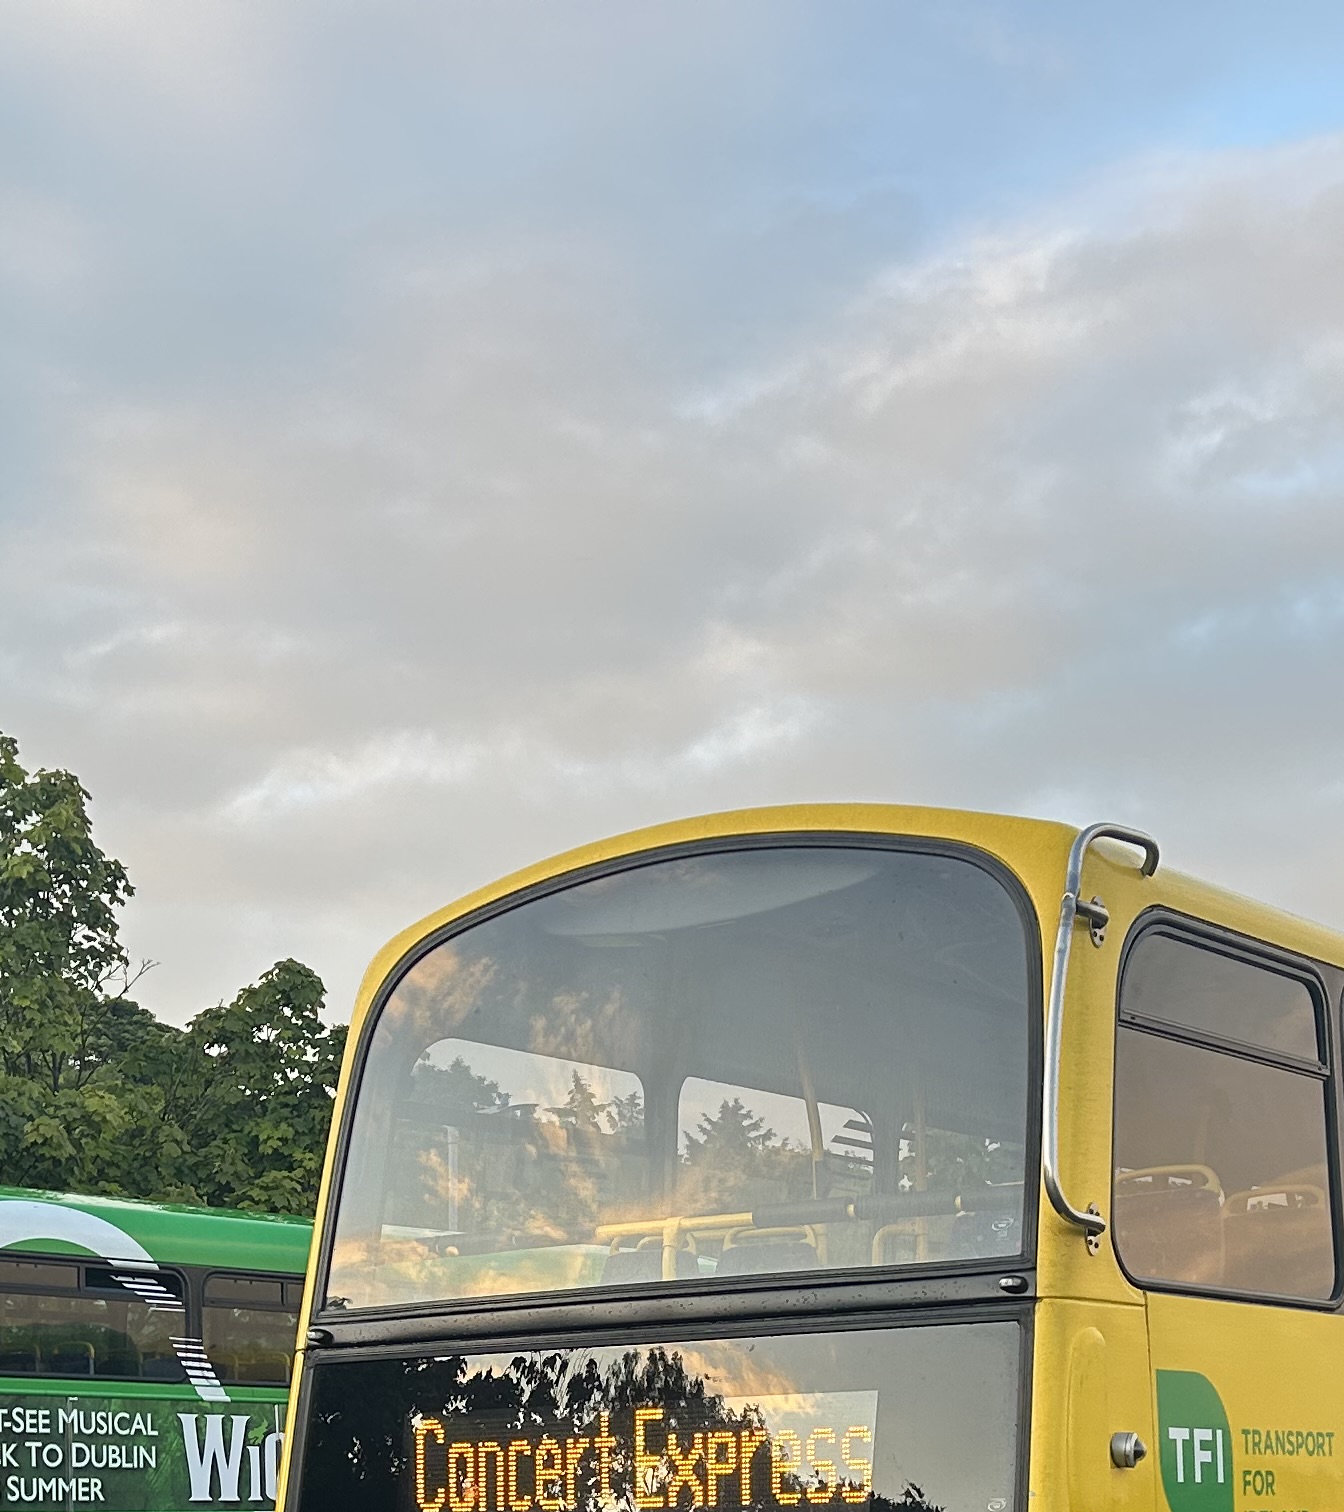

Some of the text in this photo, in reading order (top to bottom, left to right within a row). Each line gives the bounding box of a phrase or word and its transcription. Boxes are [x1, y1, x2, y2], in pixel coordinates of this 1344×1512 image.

[58, 1408, 159, 1436] MUSICAL
[25, 1441, 63, 1468] TO
[71, 1442, 157, 1469] DUBLIN
[1168, 1426, 1225, 1484] TFI
[1241, 1428, 1335, 1457] TRANSPORT
[632, 1407, 874, 1509] Express
[7, 1476, 105, 1502] SUMMER
[1242, 1470, 1276, 1496] FOR
